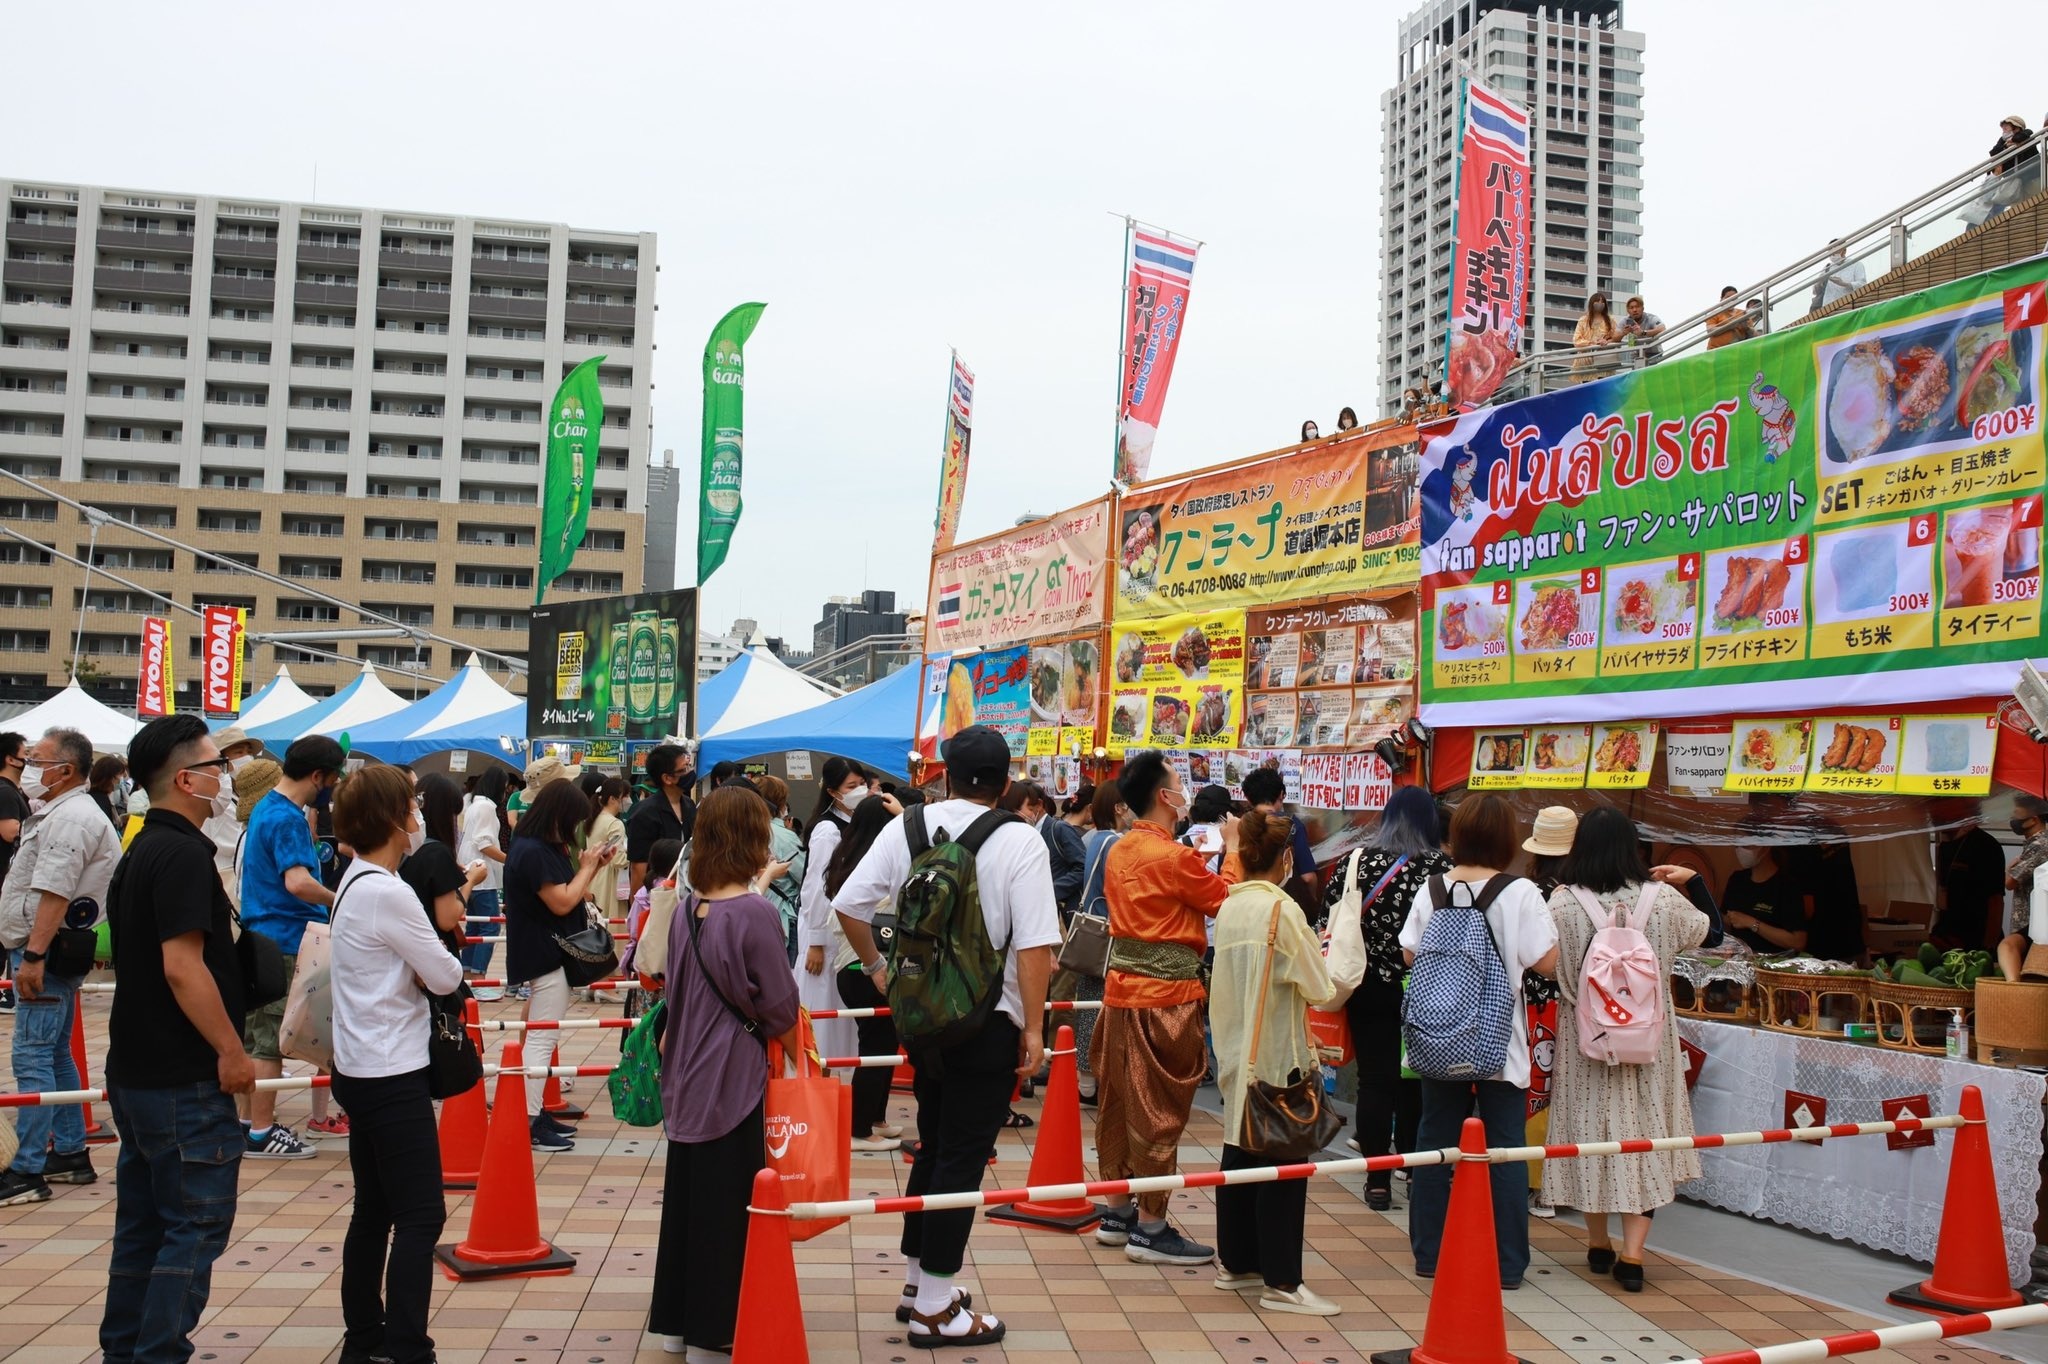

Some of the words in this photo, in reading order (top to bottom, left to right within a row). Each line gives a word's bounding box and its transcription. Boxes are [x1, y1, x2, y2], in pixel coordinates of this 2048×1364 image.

[1485, 161, 1513, 331] バーベキュー
[1462, 249, 1489, 336] チキン
[2017, 292, 2032, 321] 1
[1972, 403, 2036, 441] 600¥
[1884, 465, 1929, 485] ごはん
[1951, 447, 2012, 475] 目玉焼き
[1820, 477, 1864, 515] SET
[1866, 485, 1937, 510] チキンガパオ
[1952, 468, 2038, 495] グリーンカレー
[1171, 484, 1275, 520] タイ国政府認定レストラン
[2020, 501, 2033, 522] 7
[1285, 500, 1362, 528] タイ料理とタイスキの店
[1599, 479, 1807, 551] ファン・サパロット
[1284, 519, 1361, 556] 道頓堀本店
[1915, 519, 1929, 540] 6
[1362, 551, 1391, 569] SINCE
[1395, 546, 1421, 563] 1992
[1788, 542, 1800, 559] 5
[1683, 560, 1694, 575] 4
[1586, 573, 1596, 589] 3
[1994, 578, 2039, 600] 300¥
[1497, 585, 1507, 599] 2
[1888, 592, 1930, 612] 300¥
[1001, 610, 1036, 631] クンテープ
[1765, 606, 1800, 627] 500¥
[1947, 613, 2032, 637] タイティー
[1567, 632, 1596, 649] 500¥
[1662, 622, 1693, 639] 500¥
[1845, 624, 1893, 648] もち米
[560, 638, 582, 650] WORLD
[1705, 637, 1799, 662] フライドチキン
[145, 622, 163, 713] KYODAI
[209, 612, 232, 709] KYODAI
[560, 649, 581, 665] BEER
[1533, 656, 1577, 674] パッタイ
[1604, 645, 1692, 669] パパイヤサラダ
[559, 664, 581, 674] AWARDS
[630, 661, 656, 680] Chang
[1450, 673, 1490, 685] ガパオライス
[542, 708, 594, 724] タイNo.1ビール
[1804, 722, 1810, 730] 4
[1892, 718, 1898, 728] 5
[1989, 718, 1996, 727] 6
[1524, 730, 1529, 738] 1
[1651, 724, 1656, 732] 3
[1471, 776, 1485, 786] SET
[1608, 775, 1635, 784] パッタイ
[1822, 776, 1883, 788] フライドチキン
[1932, 779, 1961, 790] もち米
[1302, 784, 1342, 808] 7月下旬に
[1346, 784, 1360, 807] NEW
